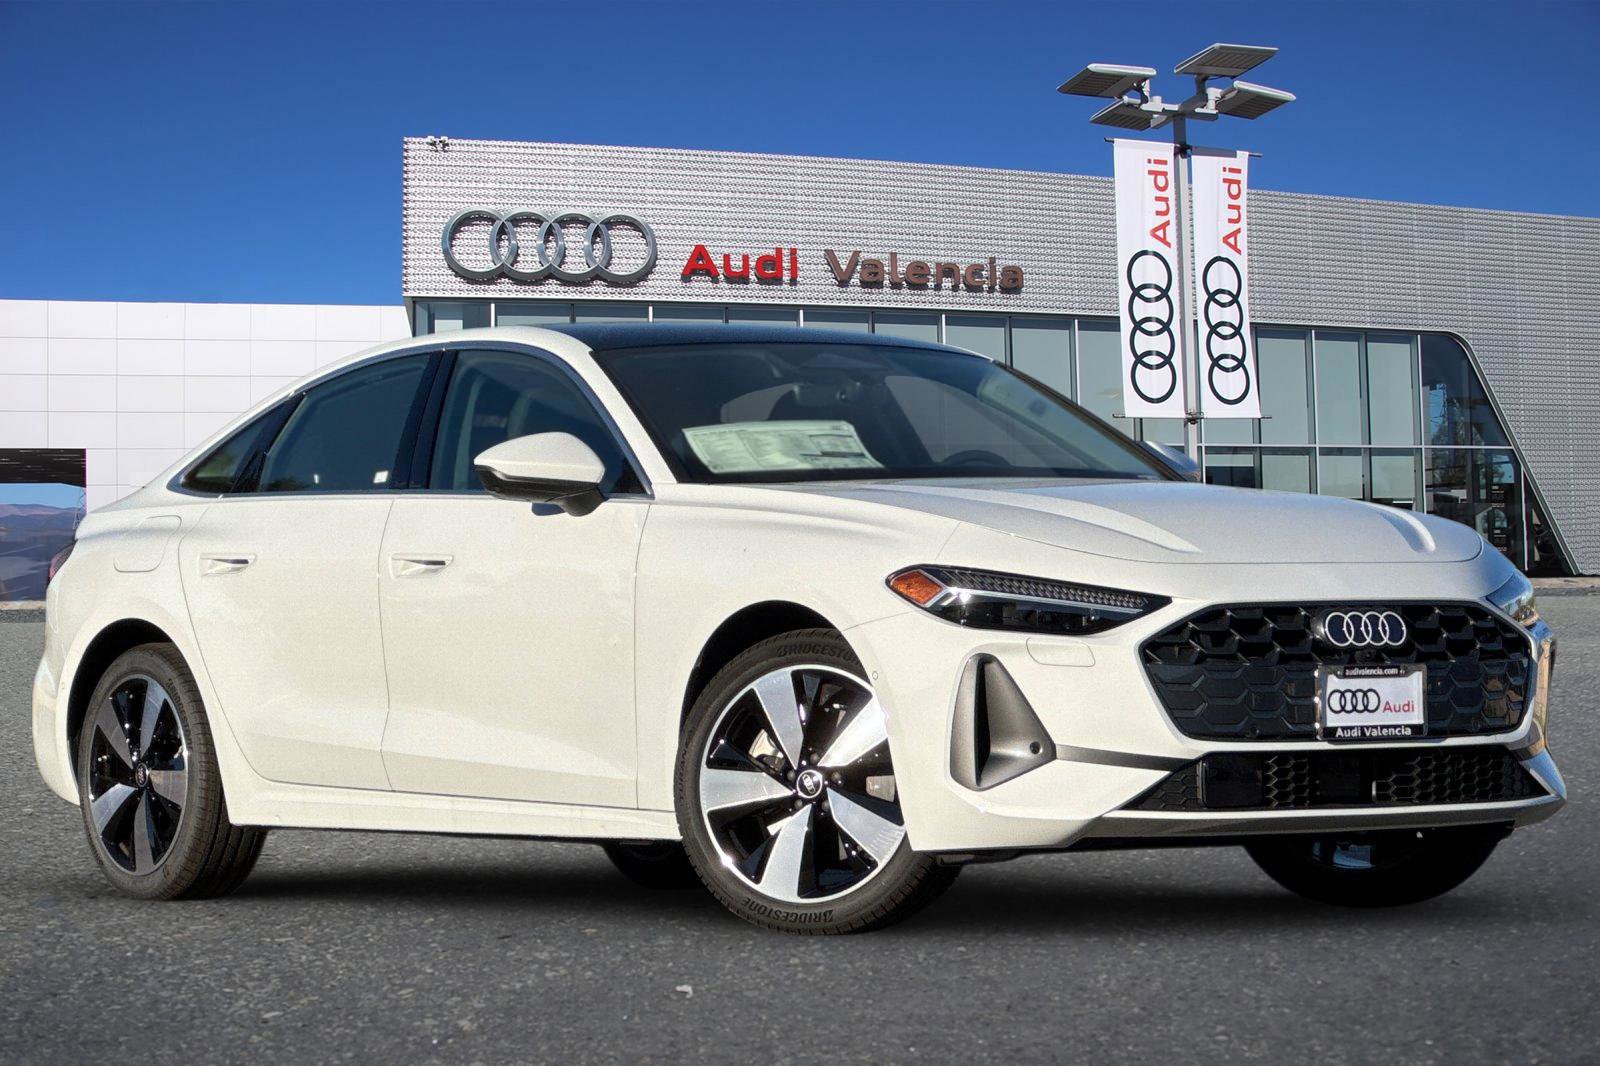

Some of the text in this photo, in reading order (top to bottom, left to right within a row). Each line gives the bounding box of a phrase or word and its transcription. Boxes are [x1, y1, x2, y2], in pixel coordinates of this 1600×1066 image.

[1147, 158, 1171, 248] Audi
[1222, 166, 1242, 255] Audi
[682, 244, 1025, 291] Audi Valencia
[1383, 701, 1415, 713] Audi
[1335, 725, 1412, 738] Audi Valencia
[742, 898, 833, 923] BRIDGESTONE
